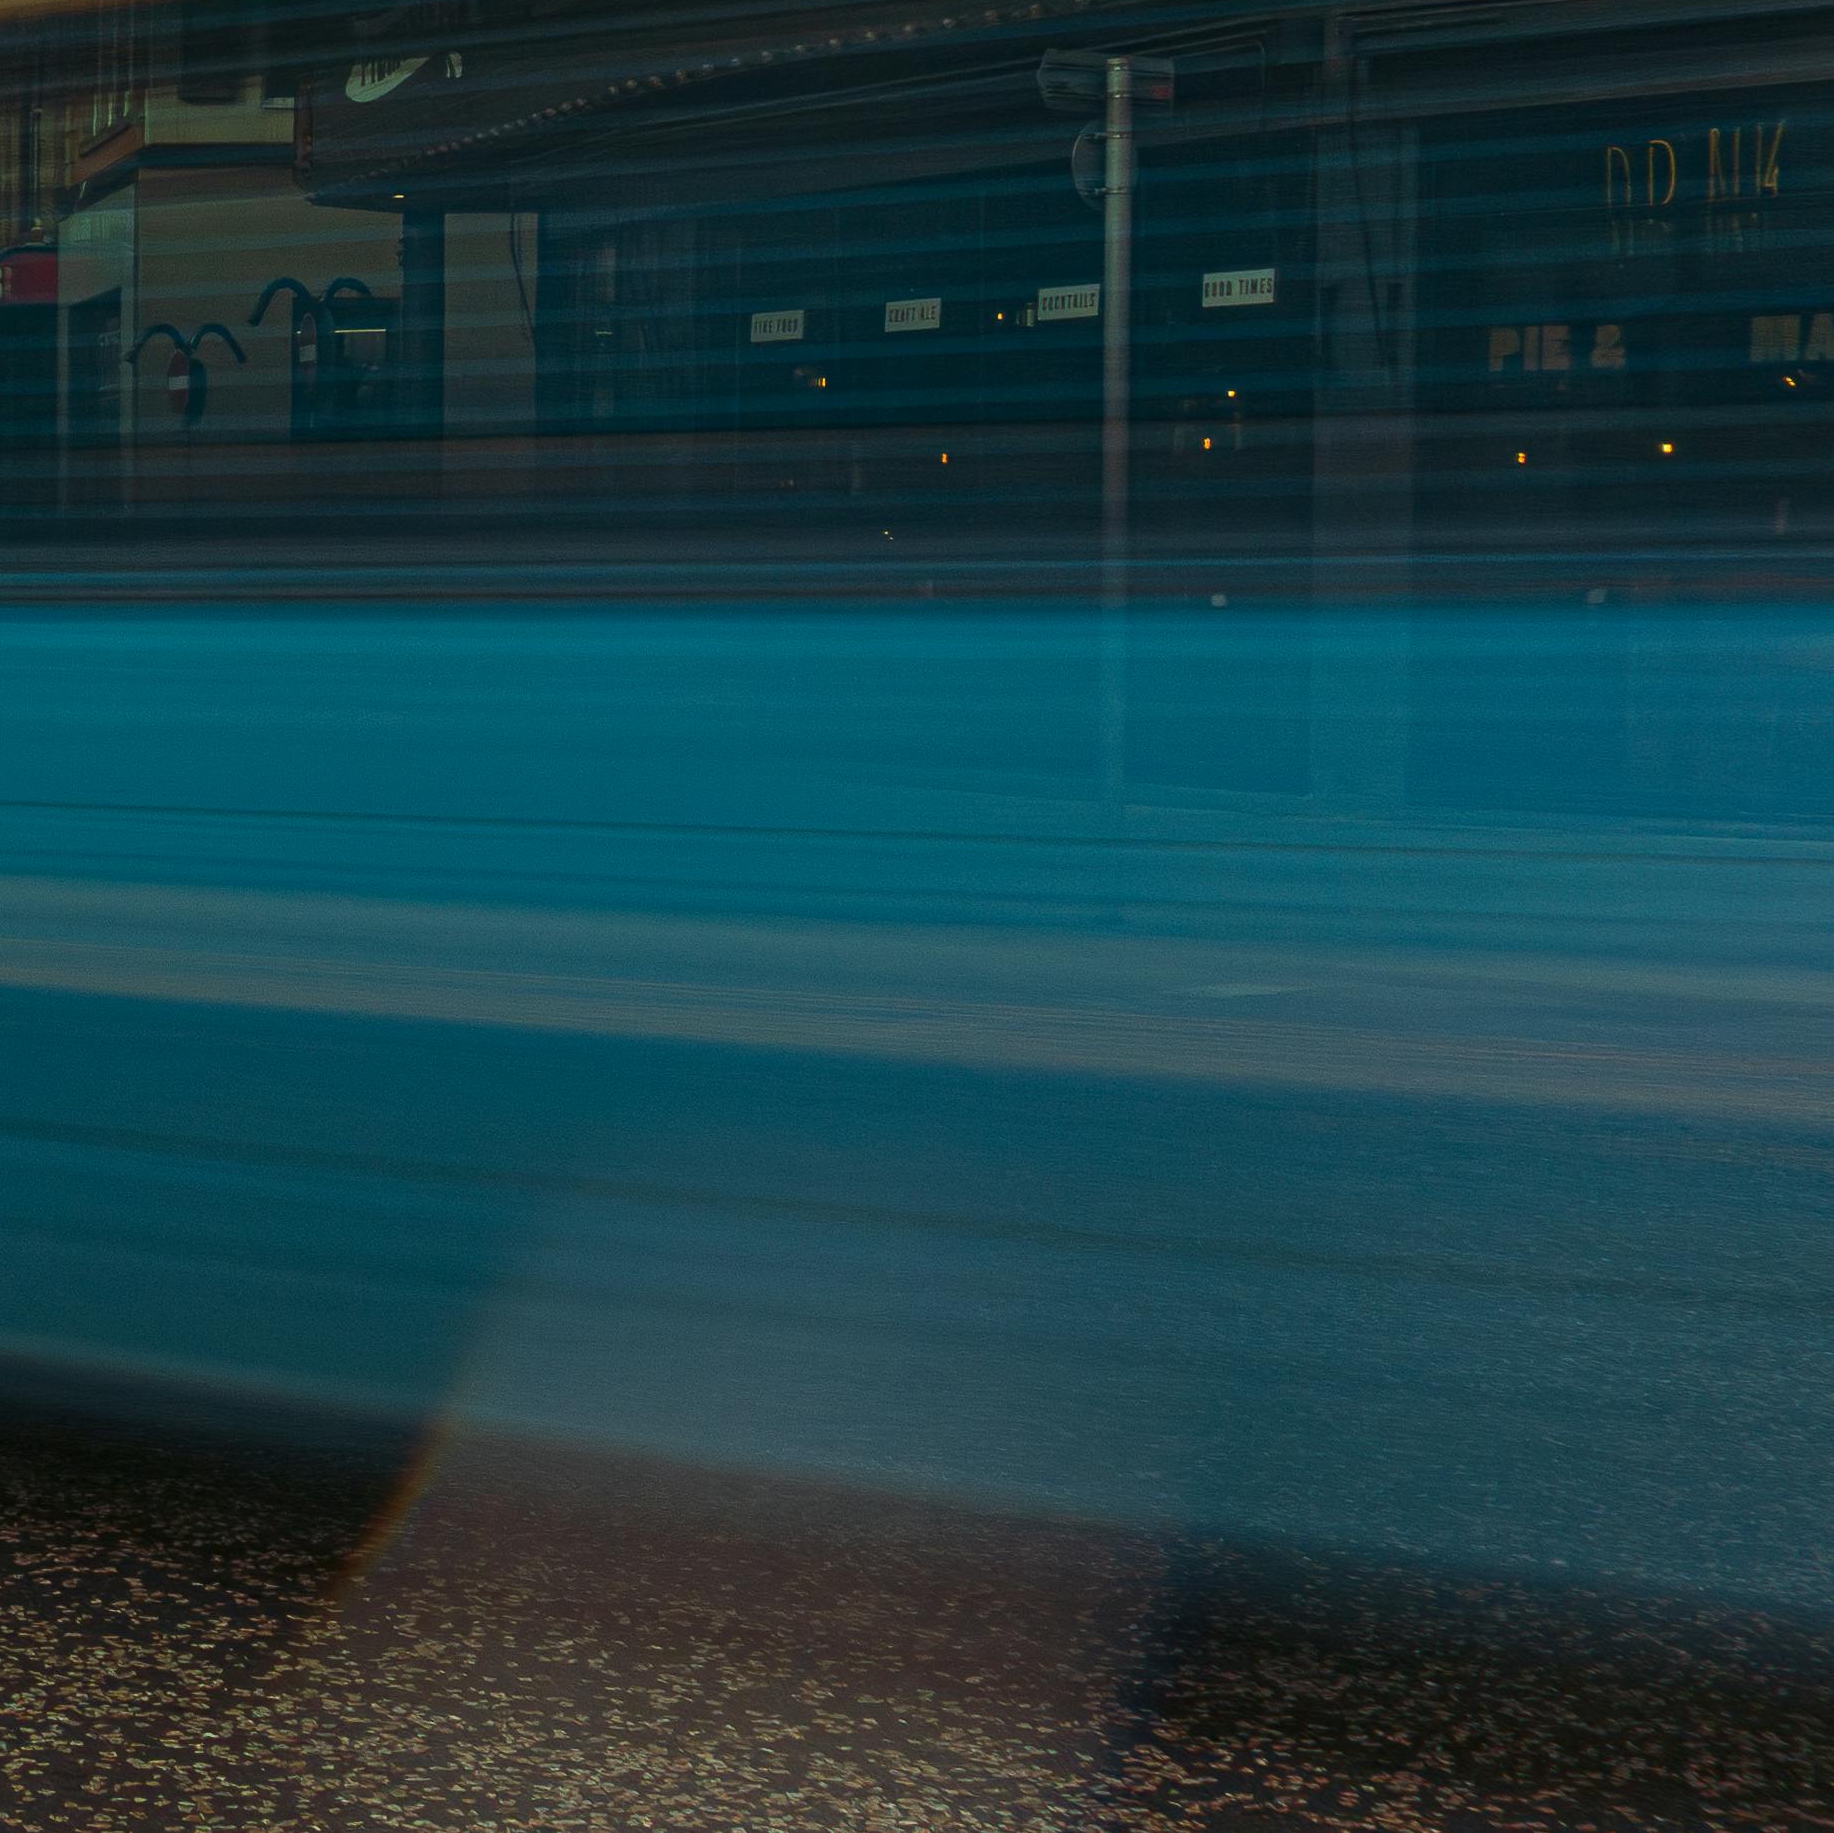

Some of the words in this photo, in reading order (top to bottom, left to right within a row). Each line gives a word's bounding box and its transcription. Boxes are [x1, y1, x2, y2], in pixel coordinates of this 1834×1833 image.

[1205, 281, 1232, 298] GOOD
[1238, 277, 1273, 296] TIMES
[1042, 292, 1097, 312] COCKTAILS
[1488, 325, 1572, 372] PIE
[1590, 324, 1626, 368] &
